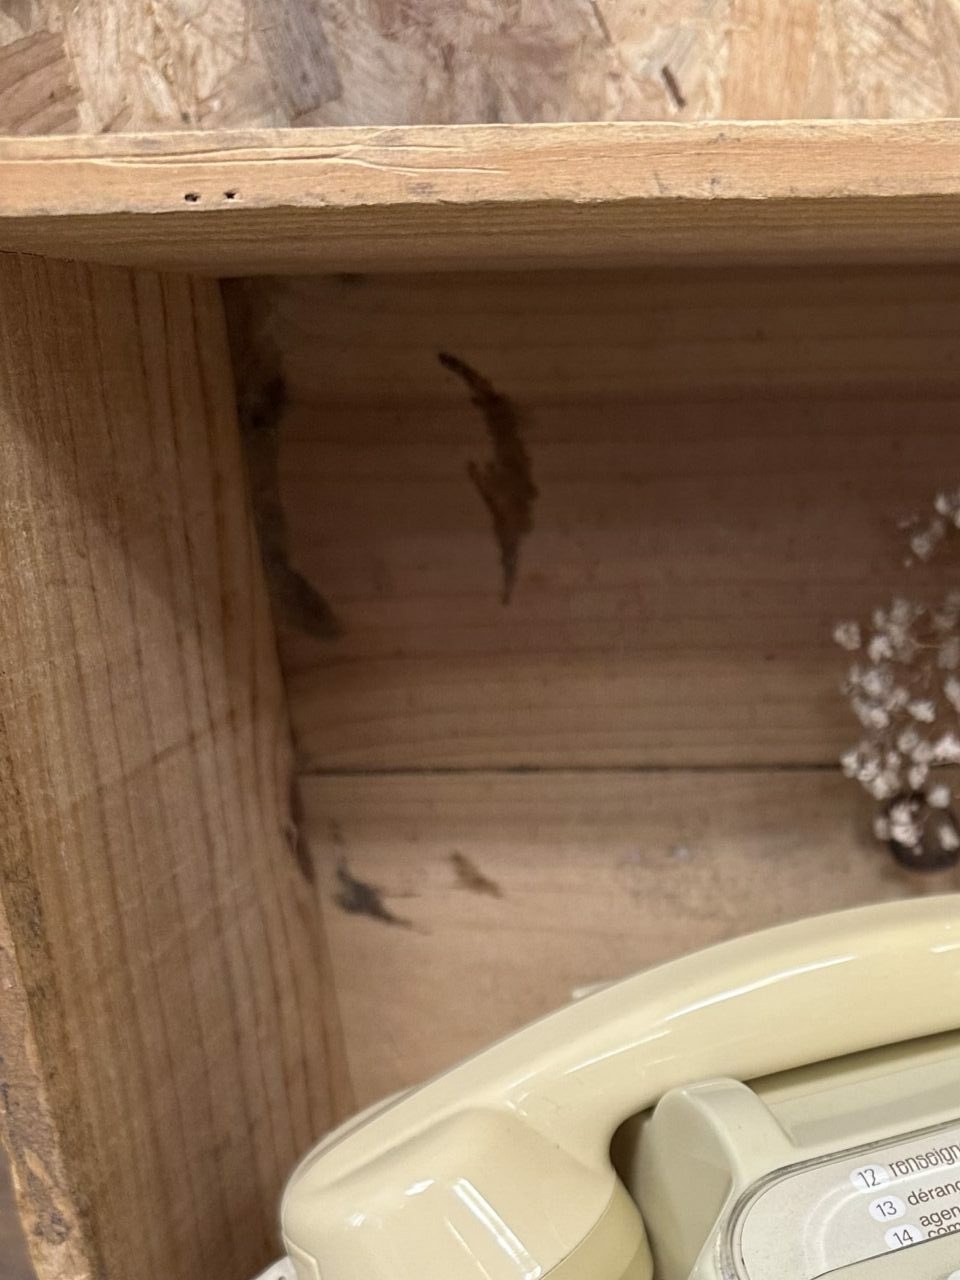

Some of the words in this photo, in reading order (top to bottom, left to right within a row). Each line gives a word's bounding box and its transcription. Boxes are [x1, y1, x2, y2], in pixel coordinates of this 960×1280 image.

[857, 1167, 882, 1189] 12
[875, 1200, 898, 1219] 13
[892, 1228, 915, 1247] 14
